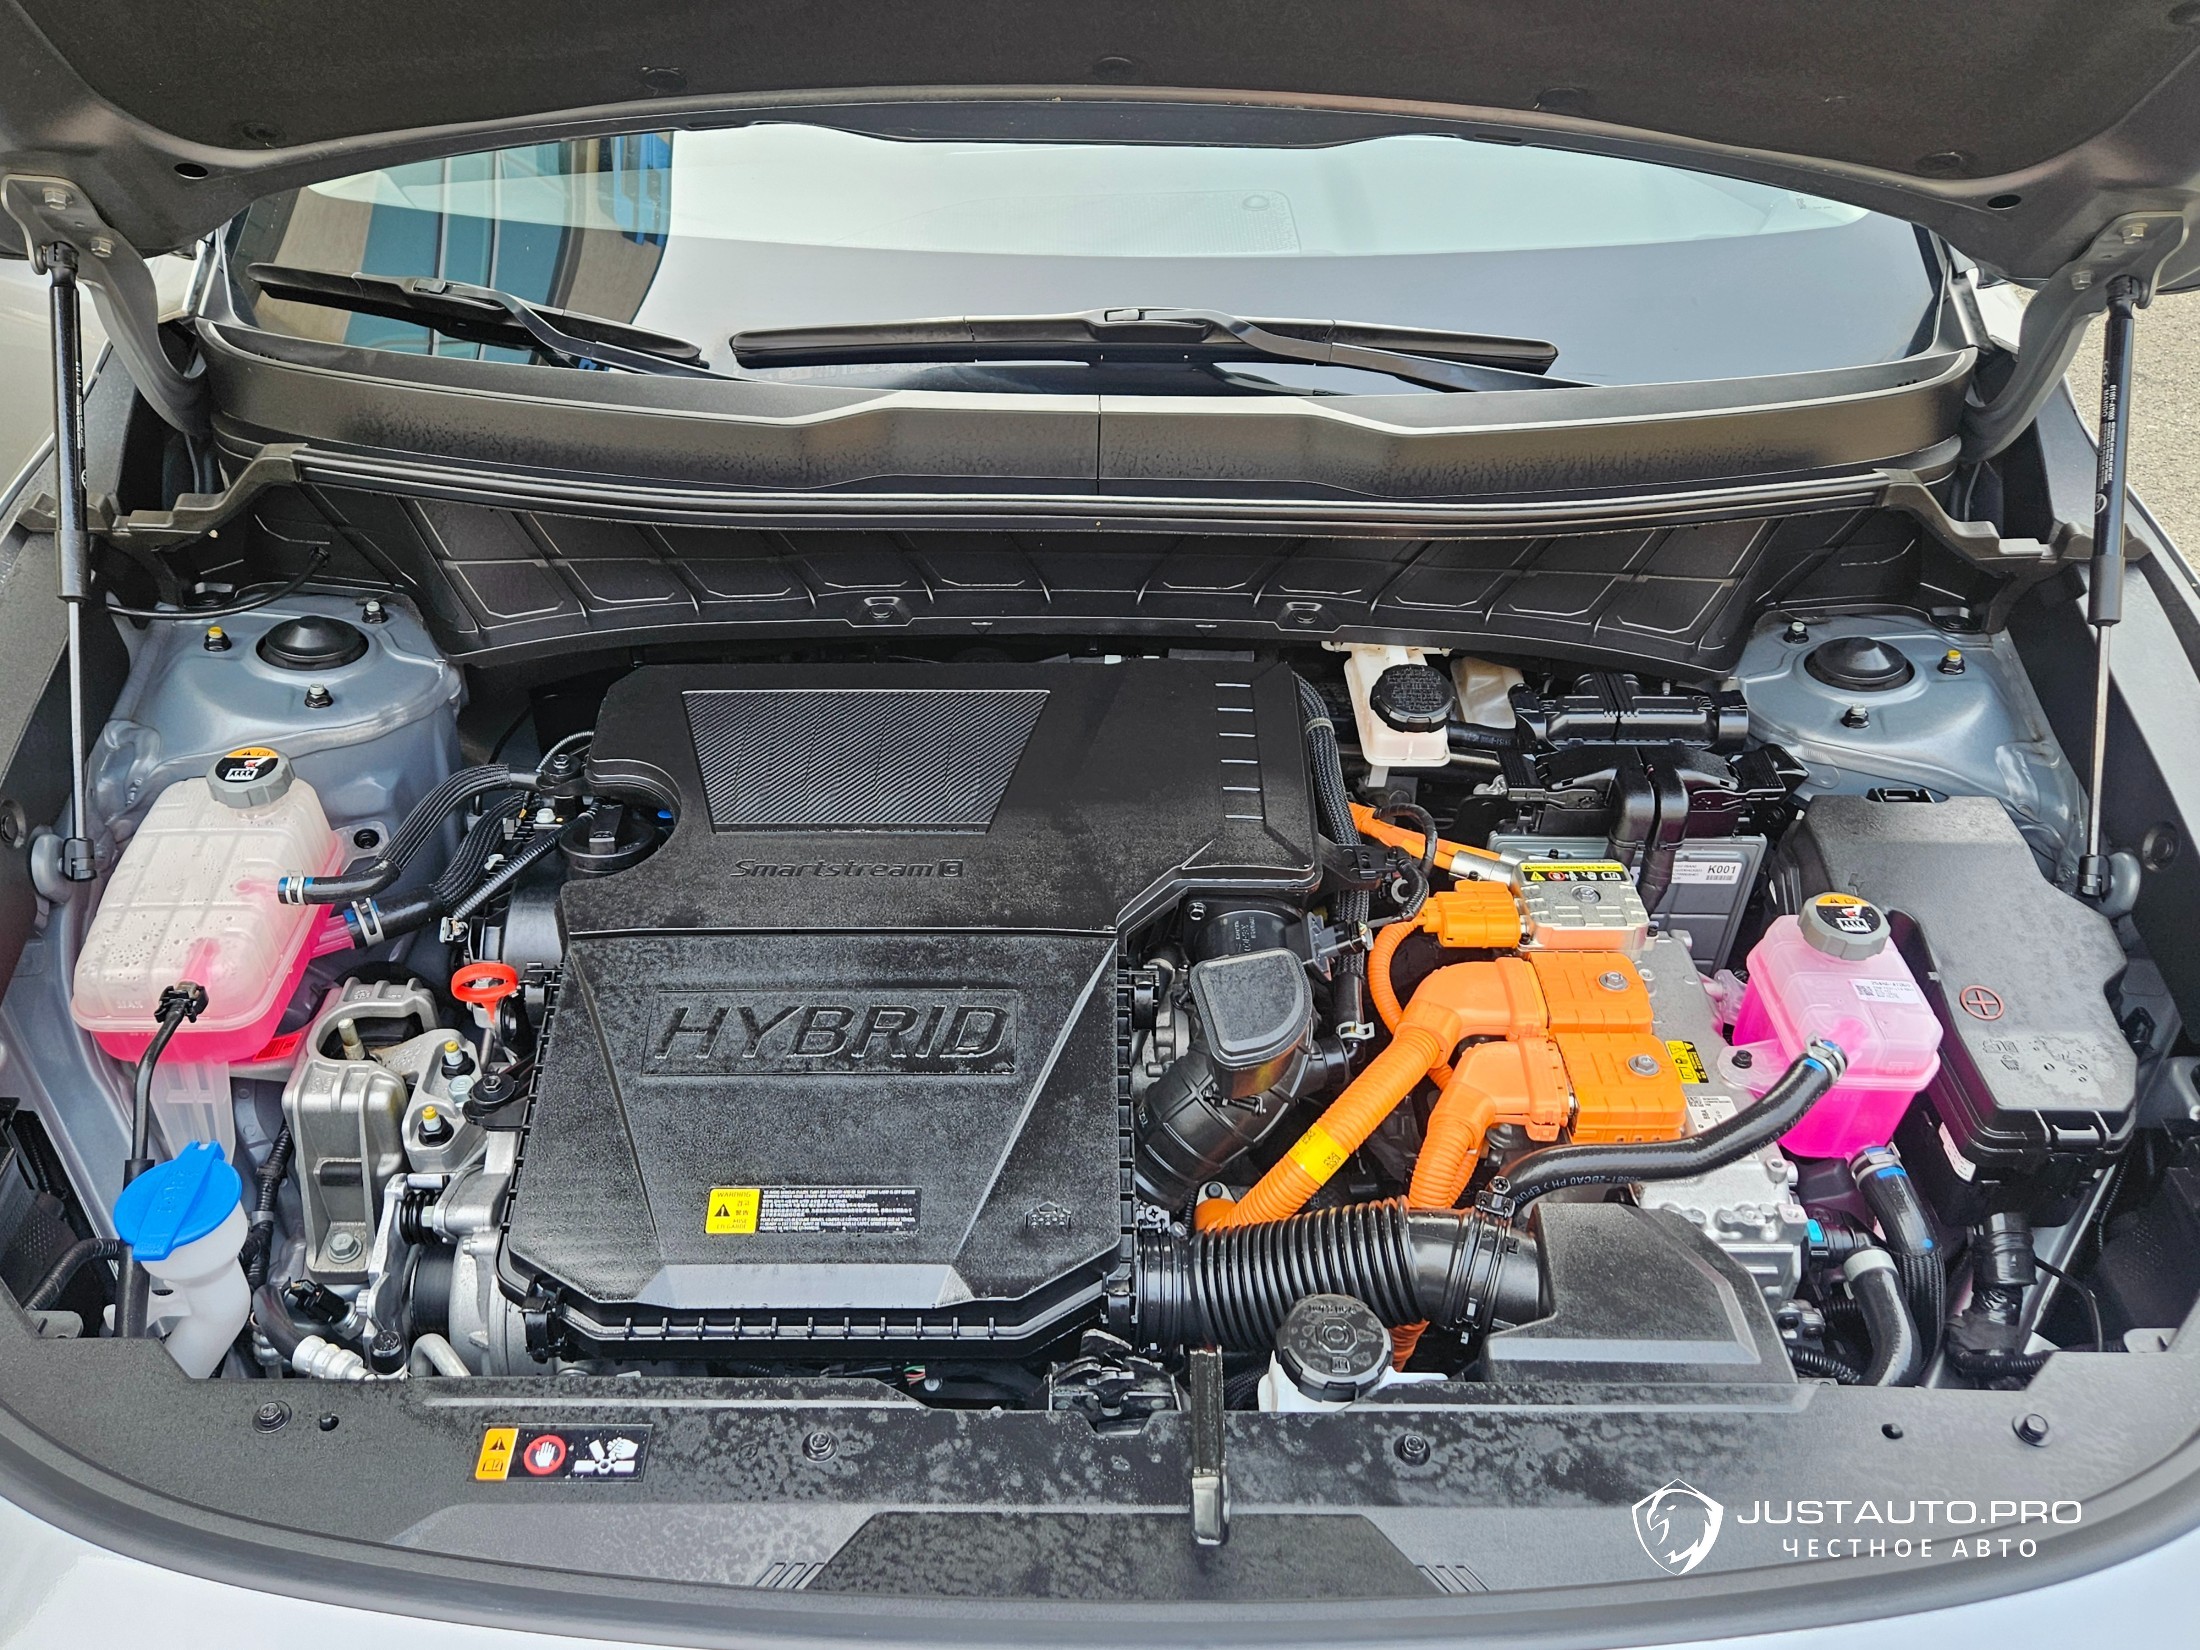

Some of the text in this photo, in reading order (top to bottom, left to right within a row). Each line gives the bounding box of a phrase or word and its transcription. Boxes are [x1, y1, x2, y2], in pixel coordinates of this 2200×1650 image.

[730, 858, 934, 877] Smartstream
[1707, 864, 1737, 874] K001
[654, 1004, 1010, 1059] HYBRID
